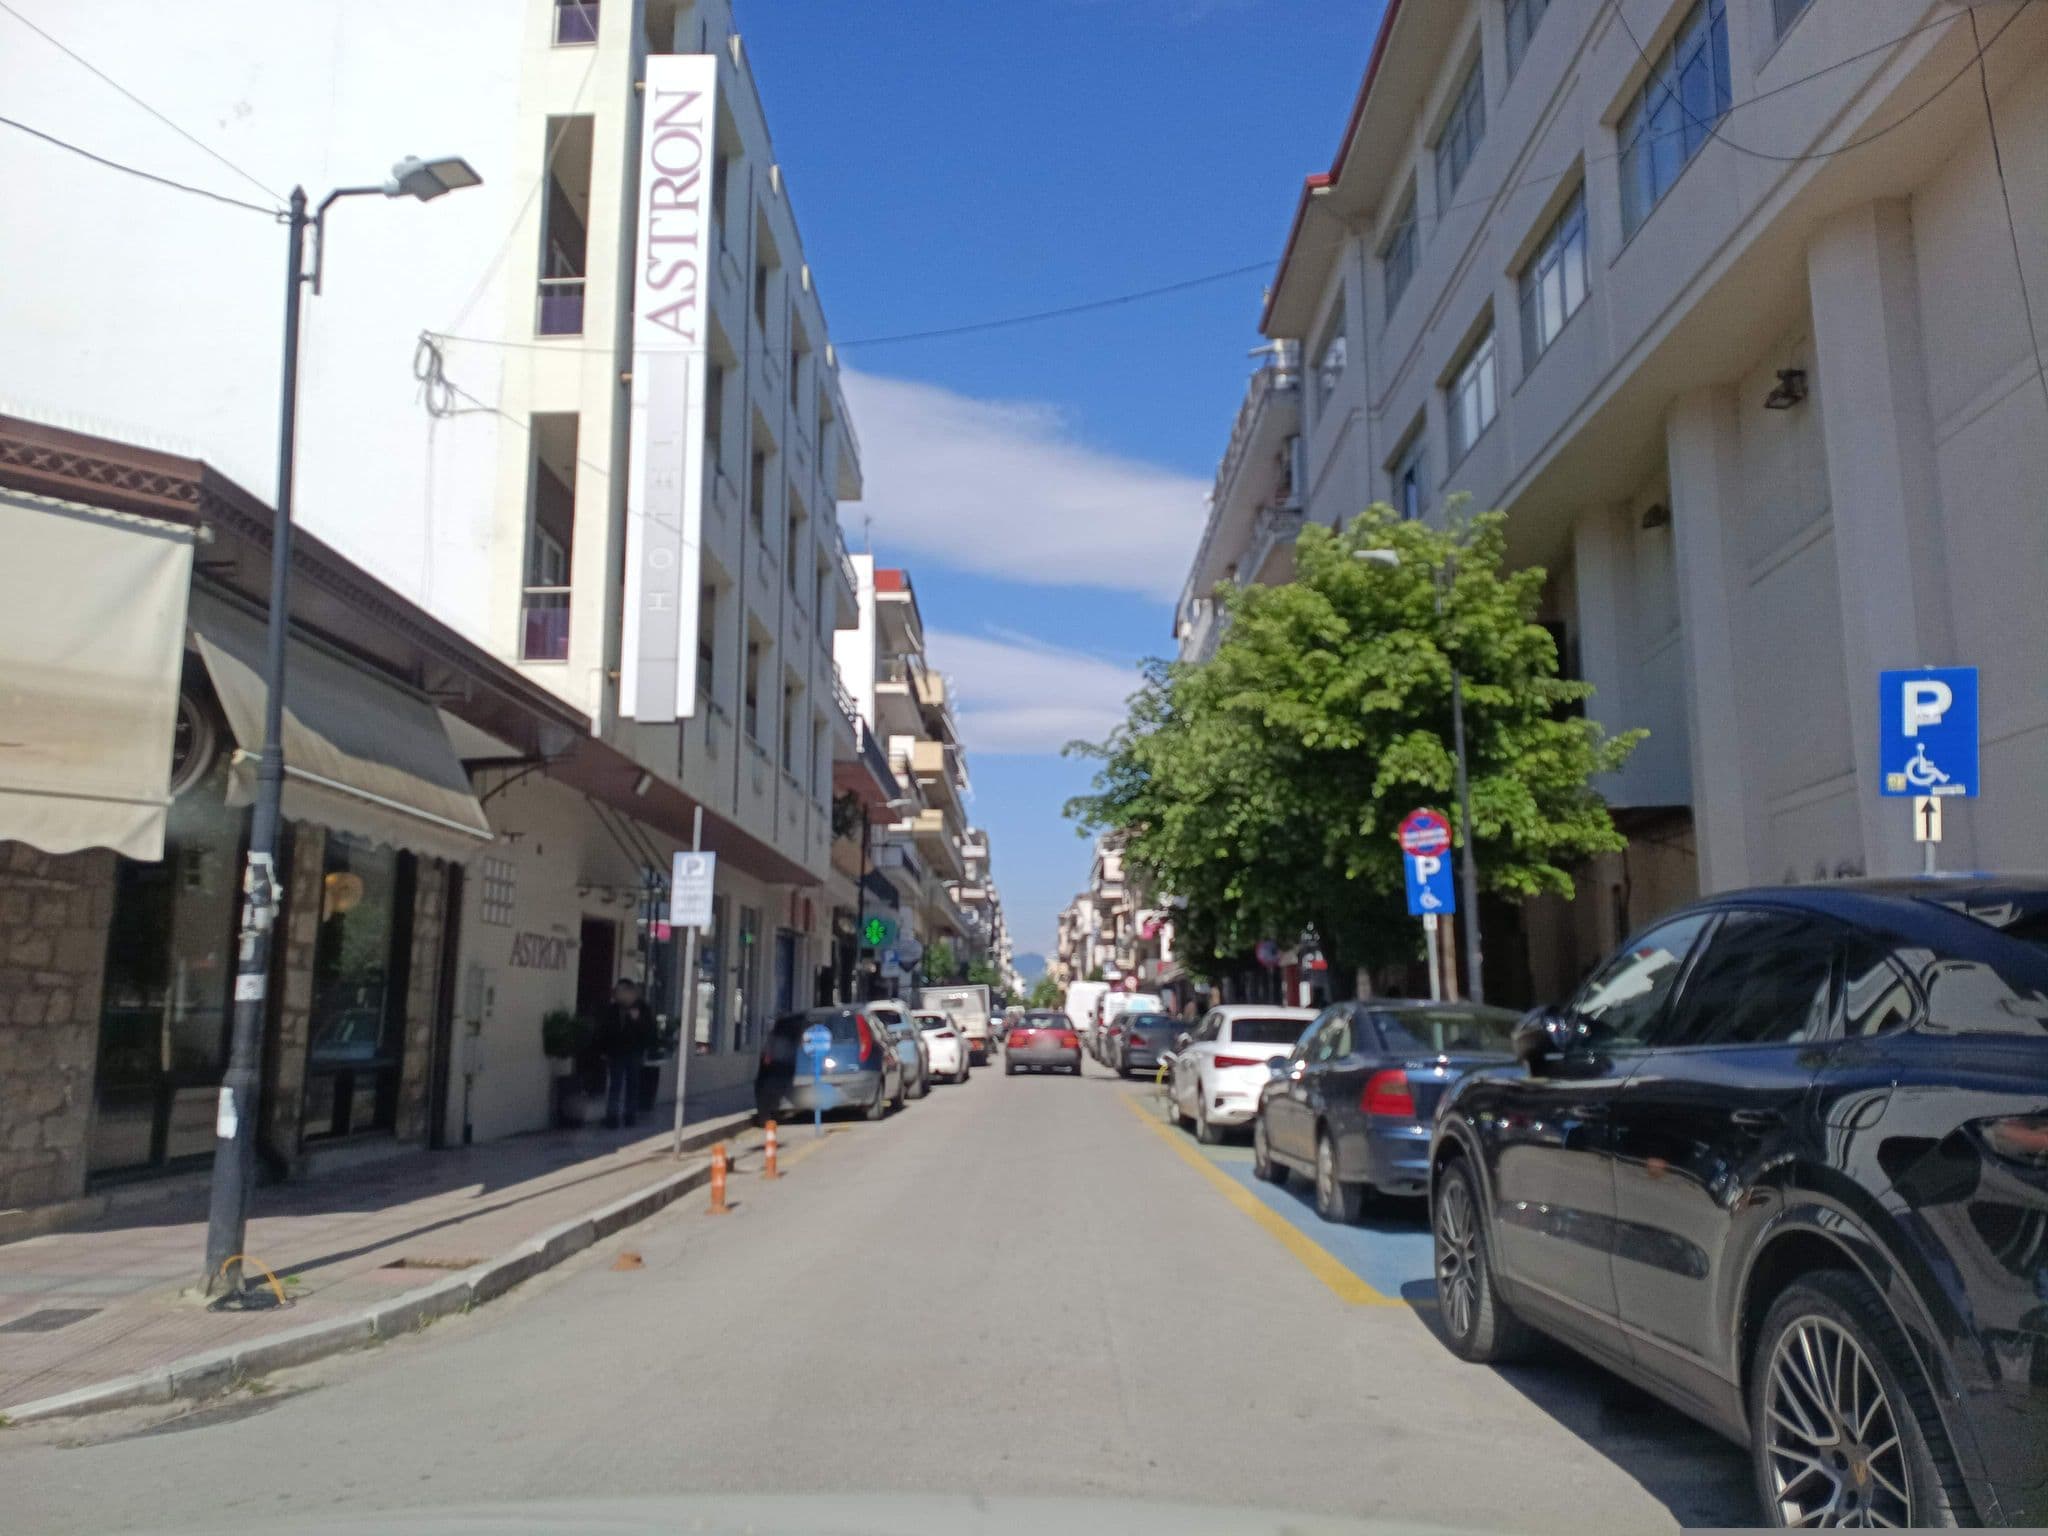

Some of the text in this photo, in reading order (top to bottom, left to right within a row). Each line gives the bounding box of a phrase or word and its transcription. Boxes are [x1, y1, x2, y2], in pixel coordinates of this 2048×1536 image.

[645, 87, 703, 344] ASTRON
[648, 429, 677, 611] HOTEL
[1903, 680, 1953, 736] P
[1415, 855, 1441, 885] P
